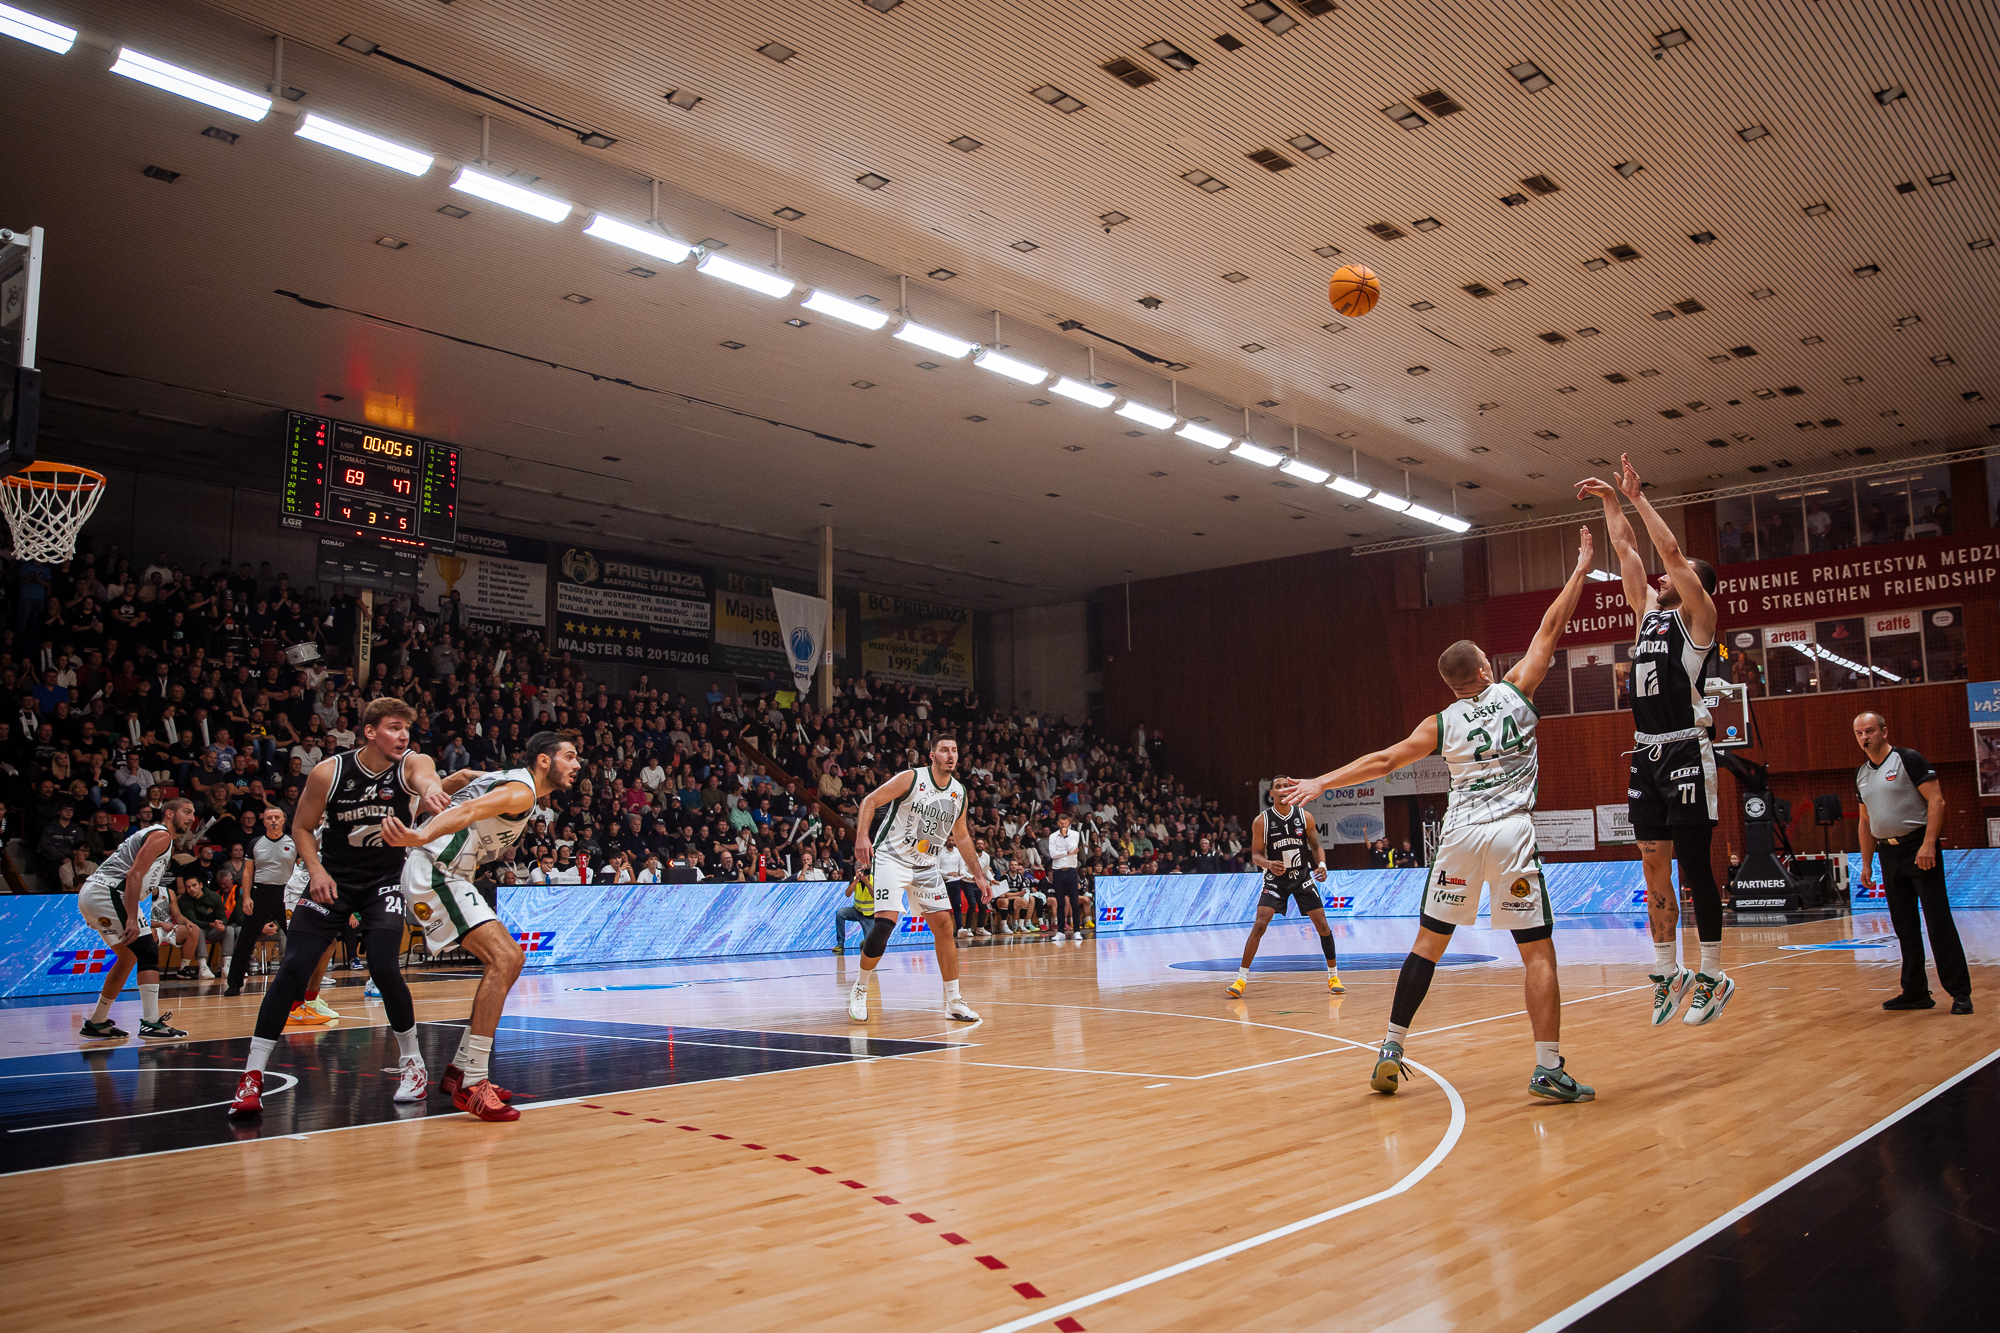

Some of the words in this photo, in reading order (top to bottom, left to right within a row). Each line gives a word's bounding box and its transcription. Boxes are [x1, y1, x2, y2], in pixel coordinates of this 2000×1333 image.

[339, 455, 366, 465] DOMÁCI
[387, 465, 411, 474] HOSTIA
[345, 469, 365, 486] 69
[393, 479, 411, 494] 47
[282, 517, 302, 526] LGR
[343, 508, 351, 519] 4
[368, 512, 377, 524] 3
[399, 517, 407, 530] 5
[457, 532, 508, 549] IEVIDZA
[395, 551, 417, 559] HOSTIA
[604, 561, 705, 588] PRIEVIDZA
[1812, 554, 1927, 583] PRIATEĽSTVA
[603, 578, 649, 590] BASKETBALL
[651, 584, 668, 592] CLUB
[670, 586, 706, 598] PRIEVIDZA
[728, 573, 754, 594] BC
[603, 591, 651, 603] ROSTAMPOUR
[681, 601, 705, 611] BATINA
[726, 598, 778, 624] Majste
[868, 595, 889, 612] BC
[893, 599, 967, 623] PRIEVIDZA
[1564, 612, 1635, 634] EVELOPIN
[1727, 598, 1749, 615] TO
[1761, 584, 1871, 610] STRENGTHEN
[1884, 568, 1997, 596] FRIENDSHIP
[559, 603, 589, 613] HULJAK
[594, 608, 619, 617] HUPKA
[683, 618, 708, 628] VOJTEK
[1771, 630, 1807, 644] arena
[1877, 614, 1910, 632] caffé
[558, 638, 622, 656] MAJSTER
[626, 646, 643, 658] SR
[647, 648, 709, 665] 2015/2016
[869, 641, 918, 657] európskej
[922, 649, 965, 662] superligy
[888, 656, 919, 671] 1995
[1467, 715, 1529, 762] 24
[1336, 789, 1354, 798] DOB
[1678, 783, 1696, 804] 77
[923, 820, 938, 836] 32
[1284, 824, 1289, 835] 1
[1737, 879, 1786, 889] PARTNERS
[465, 892, 479, 906] 7
[876, 889, 889, 900] 32
[385, 896, 402, 914] 24
